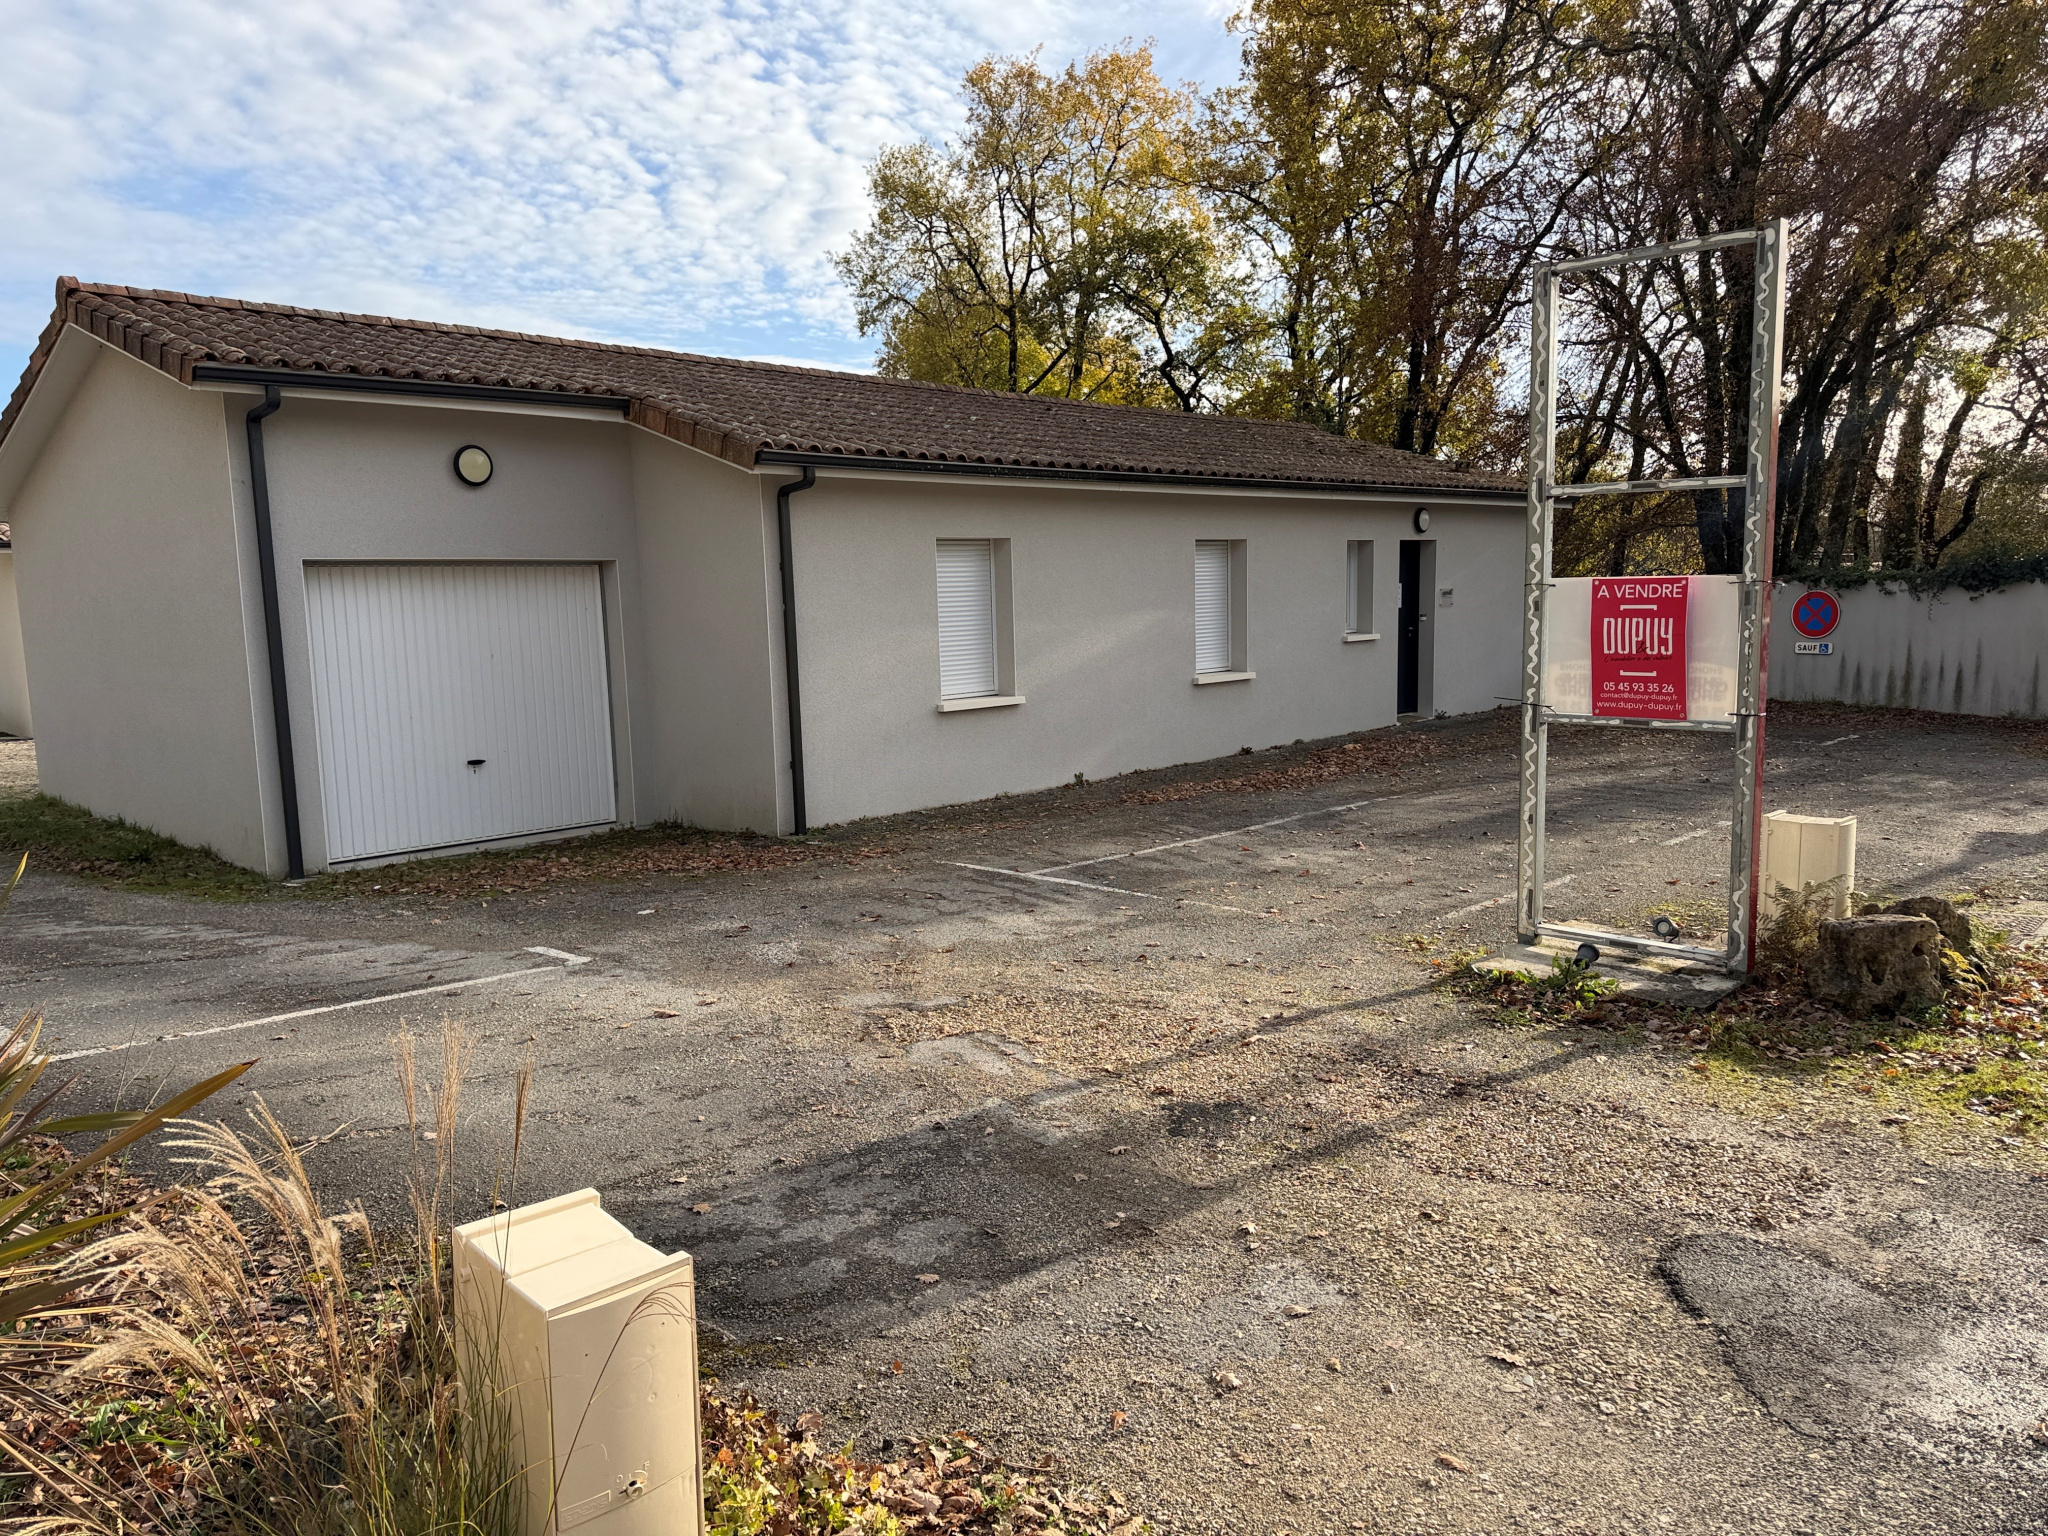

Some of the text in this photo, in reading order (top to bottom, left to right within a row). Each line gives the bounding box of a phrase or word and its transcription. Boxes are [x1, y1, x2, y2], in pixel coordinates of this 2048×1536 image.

[1597, 583, 1683, 599] A VENDRE
[1603, 617, 1674, 656] DUPUY
[1636, 641, 1648, 654] &
[1603, 681, 1675, 693] 05 45 93 35 26
[1600, 692, 1678, 701] contact@dupuy-dupuy.fr
[1596, 701, 1682, 711] www.dupuy-dupuy.fr
